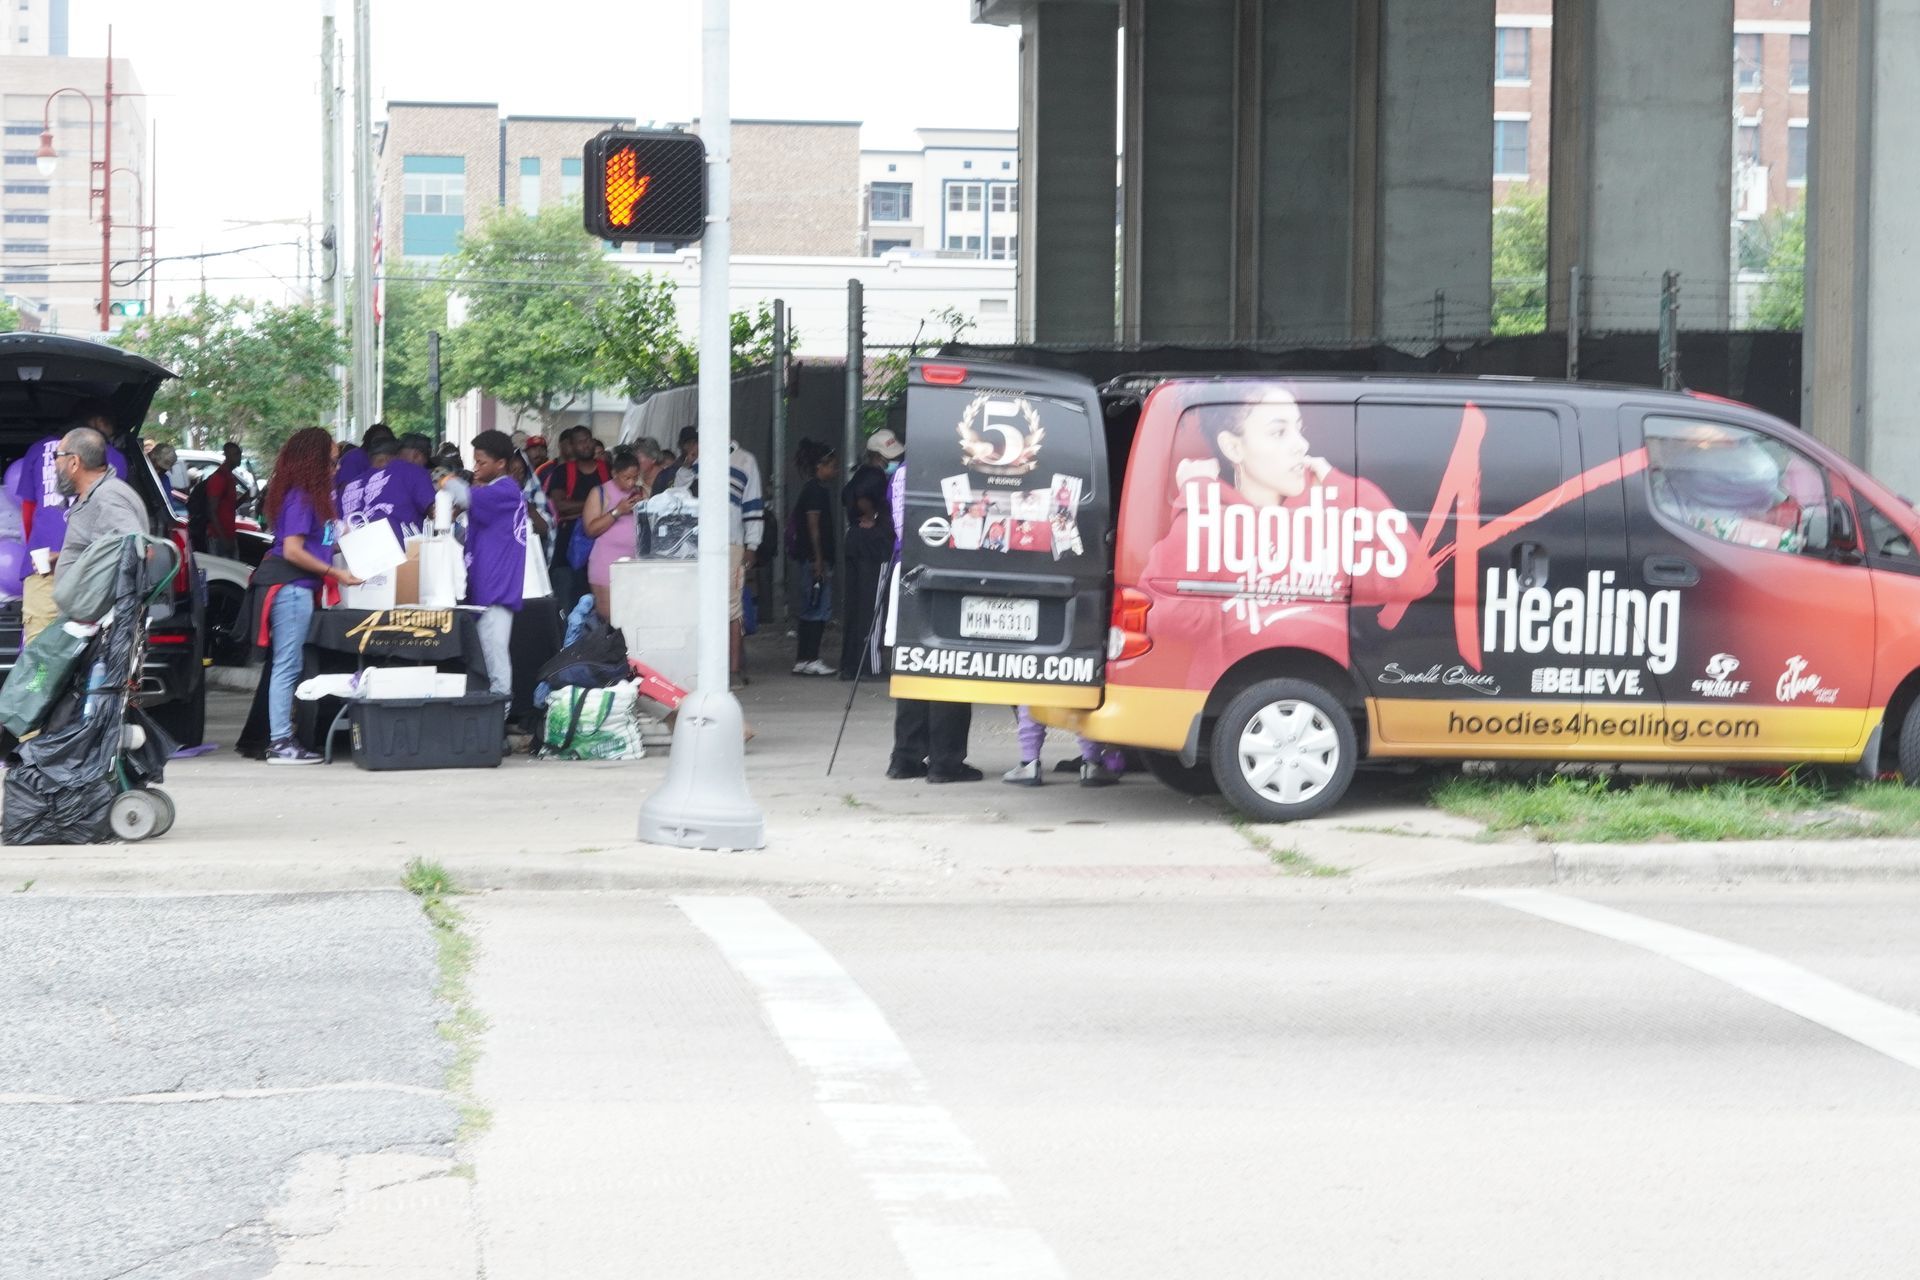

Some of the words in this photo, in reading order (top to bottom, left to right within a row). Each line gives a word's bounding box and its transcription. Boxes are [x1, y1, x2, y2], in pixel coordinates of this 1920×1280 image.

[1185, 481, 1408, 578] Hoodies
[1483, 567, 1680, 675] Healing
[894, 646, 1094, 683] ES4HEALING.COM
[1448, 711, 1759, 741] hoodies4healing.com
